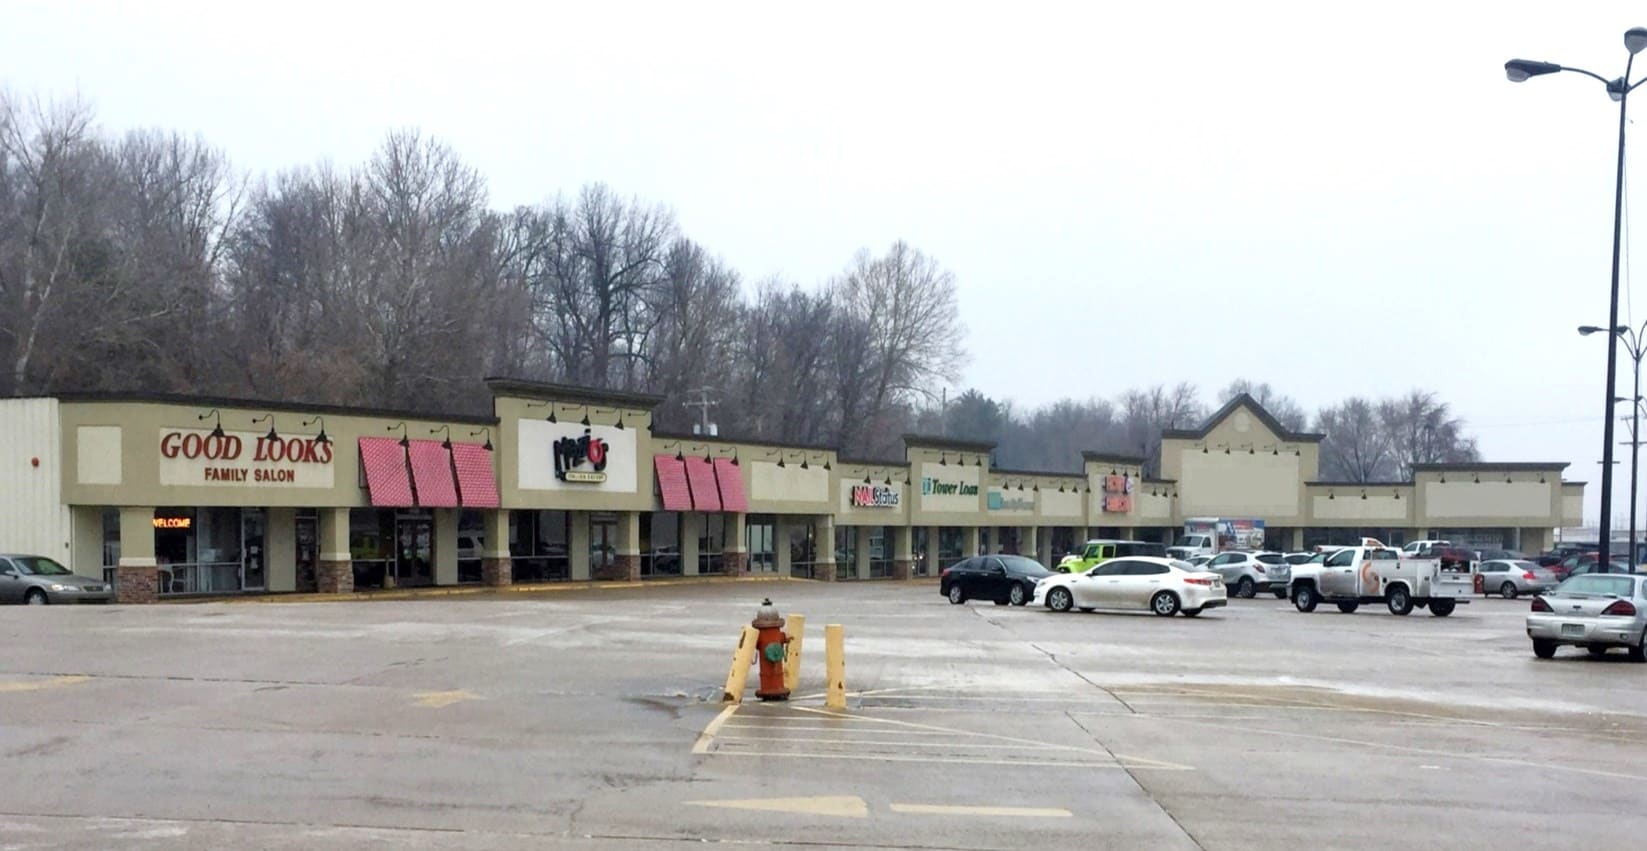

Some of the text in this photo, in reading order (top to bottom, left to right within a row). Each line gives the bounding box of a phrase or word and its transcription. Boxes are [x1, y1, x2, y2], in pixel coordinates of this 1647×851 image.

[160, 432, 333, 464] GOOD LOOKS
[204, 467, 295, 483] FAMILY SALON
[932, 478, 978, 496] Tower Loan
